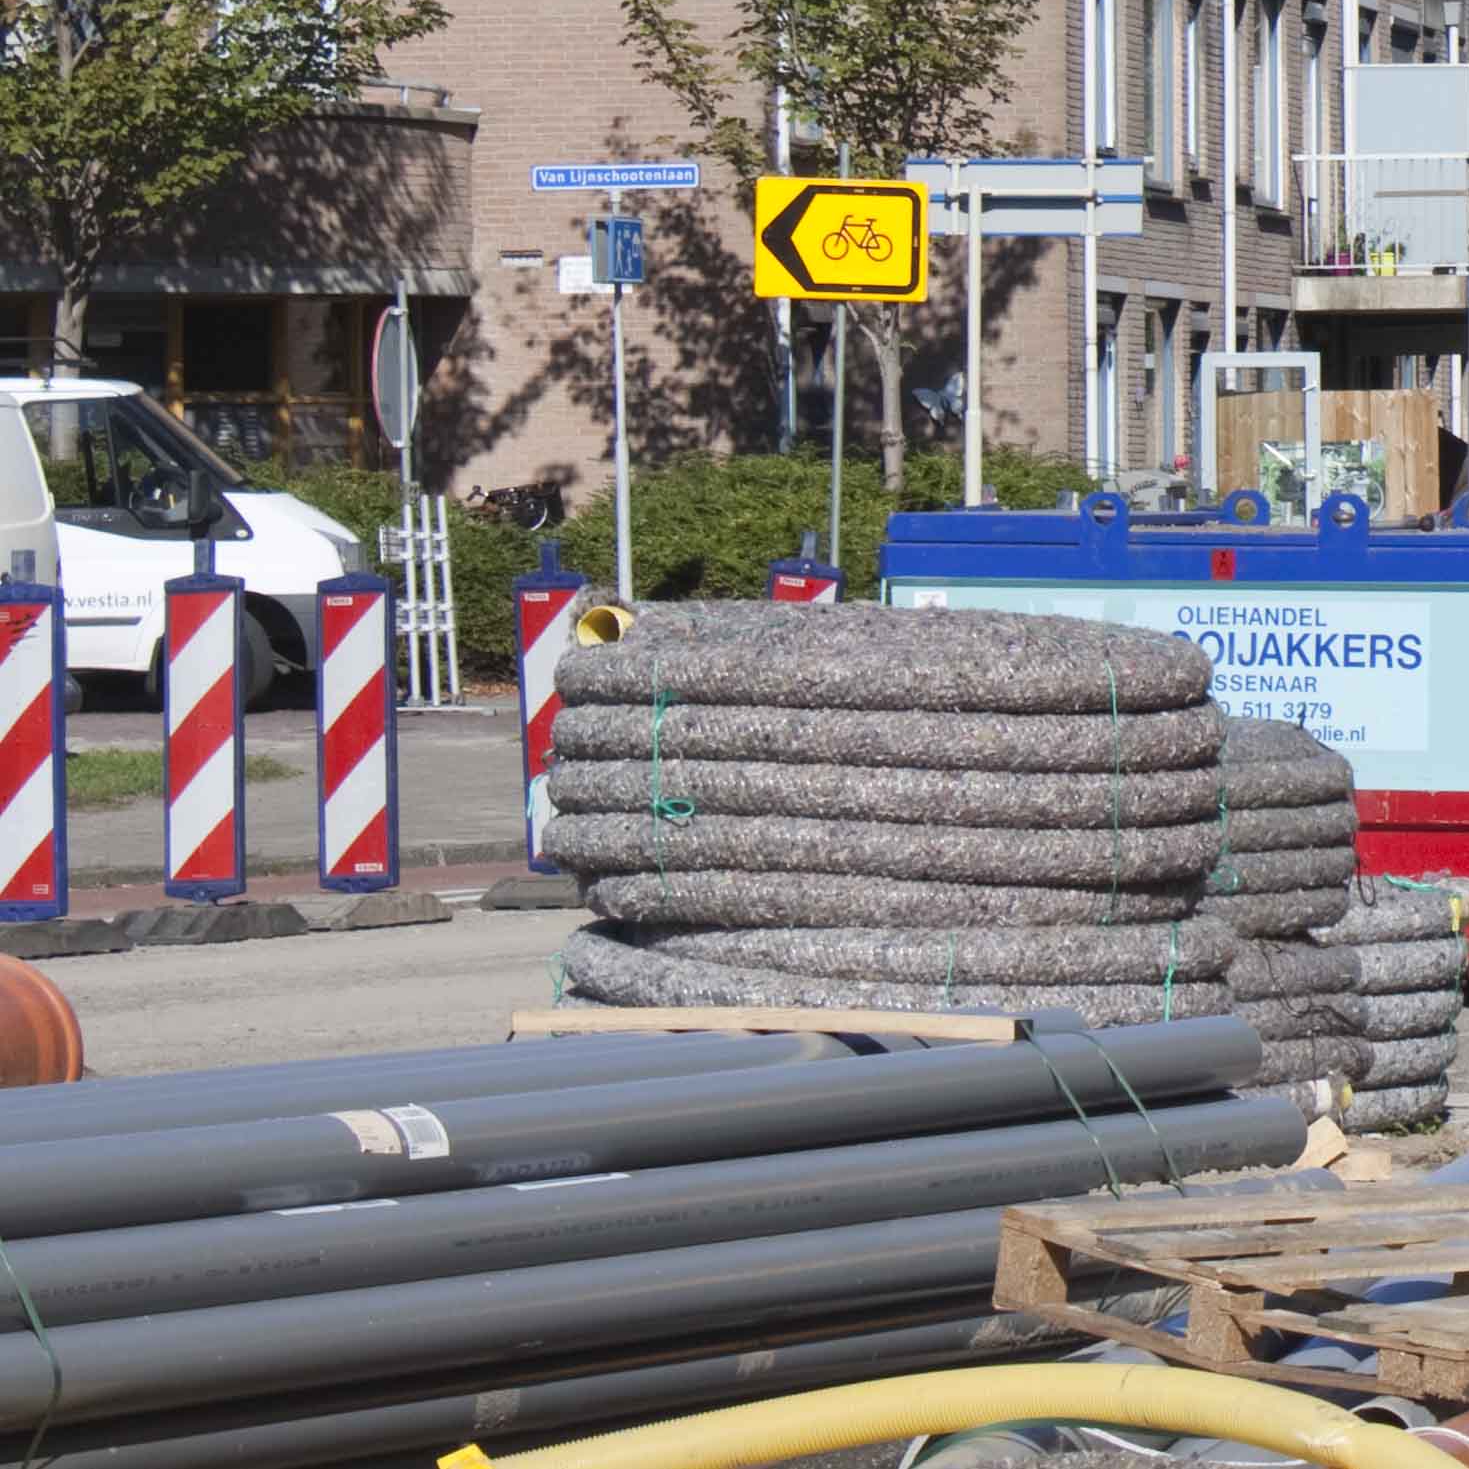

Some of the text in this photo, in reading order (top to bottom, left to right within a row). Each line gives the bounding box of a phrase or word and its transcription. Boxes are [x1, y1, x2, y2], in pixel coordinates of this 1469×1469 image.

[539, 169, 693, 185] Van Lijnschootenlaan
[1177, 606, 1328, 628] OLIEHANDEL
[1172, 630, 1423, 670] OIJAKKERS
[1208, 674, 1318, 693] SSENAAR
[1242, 701, 1272, 720] 511
[1282, 701, 1332, 720] 3279
